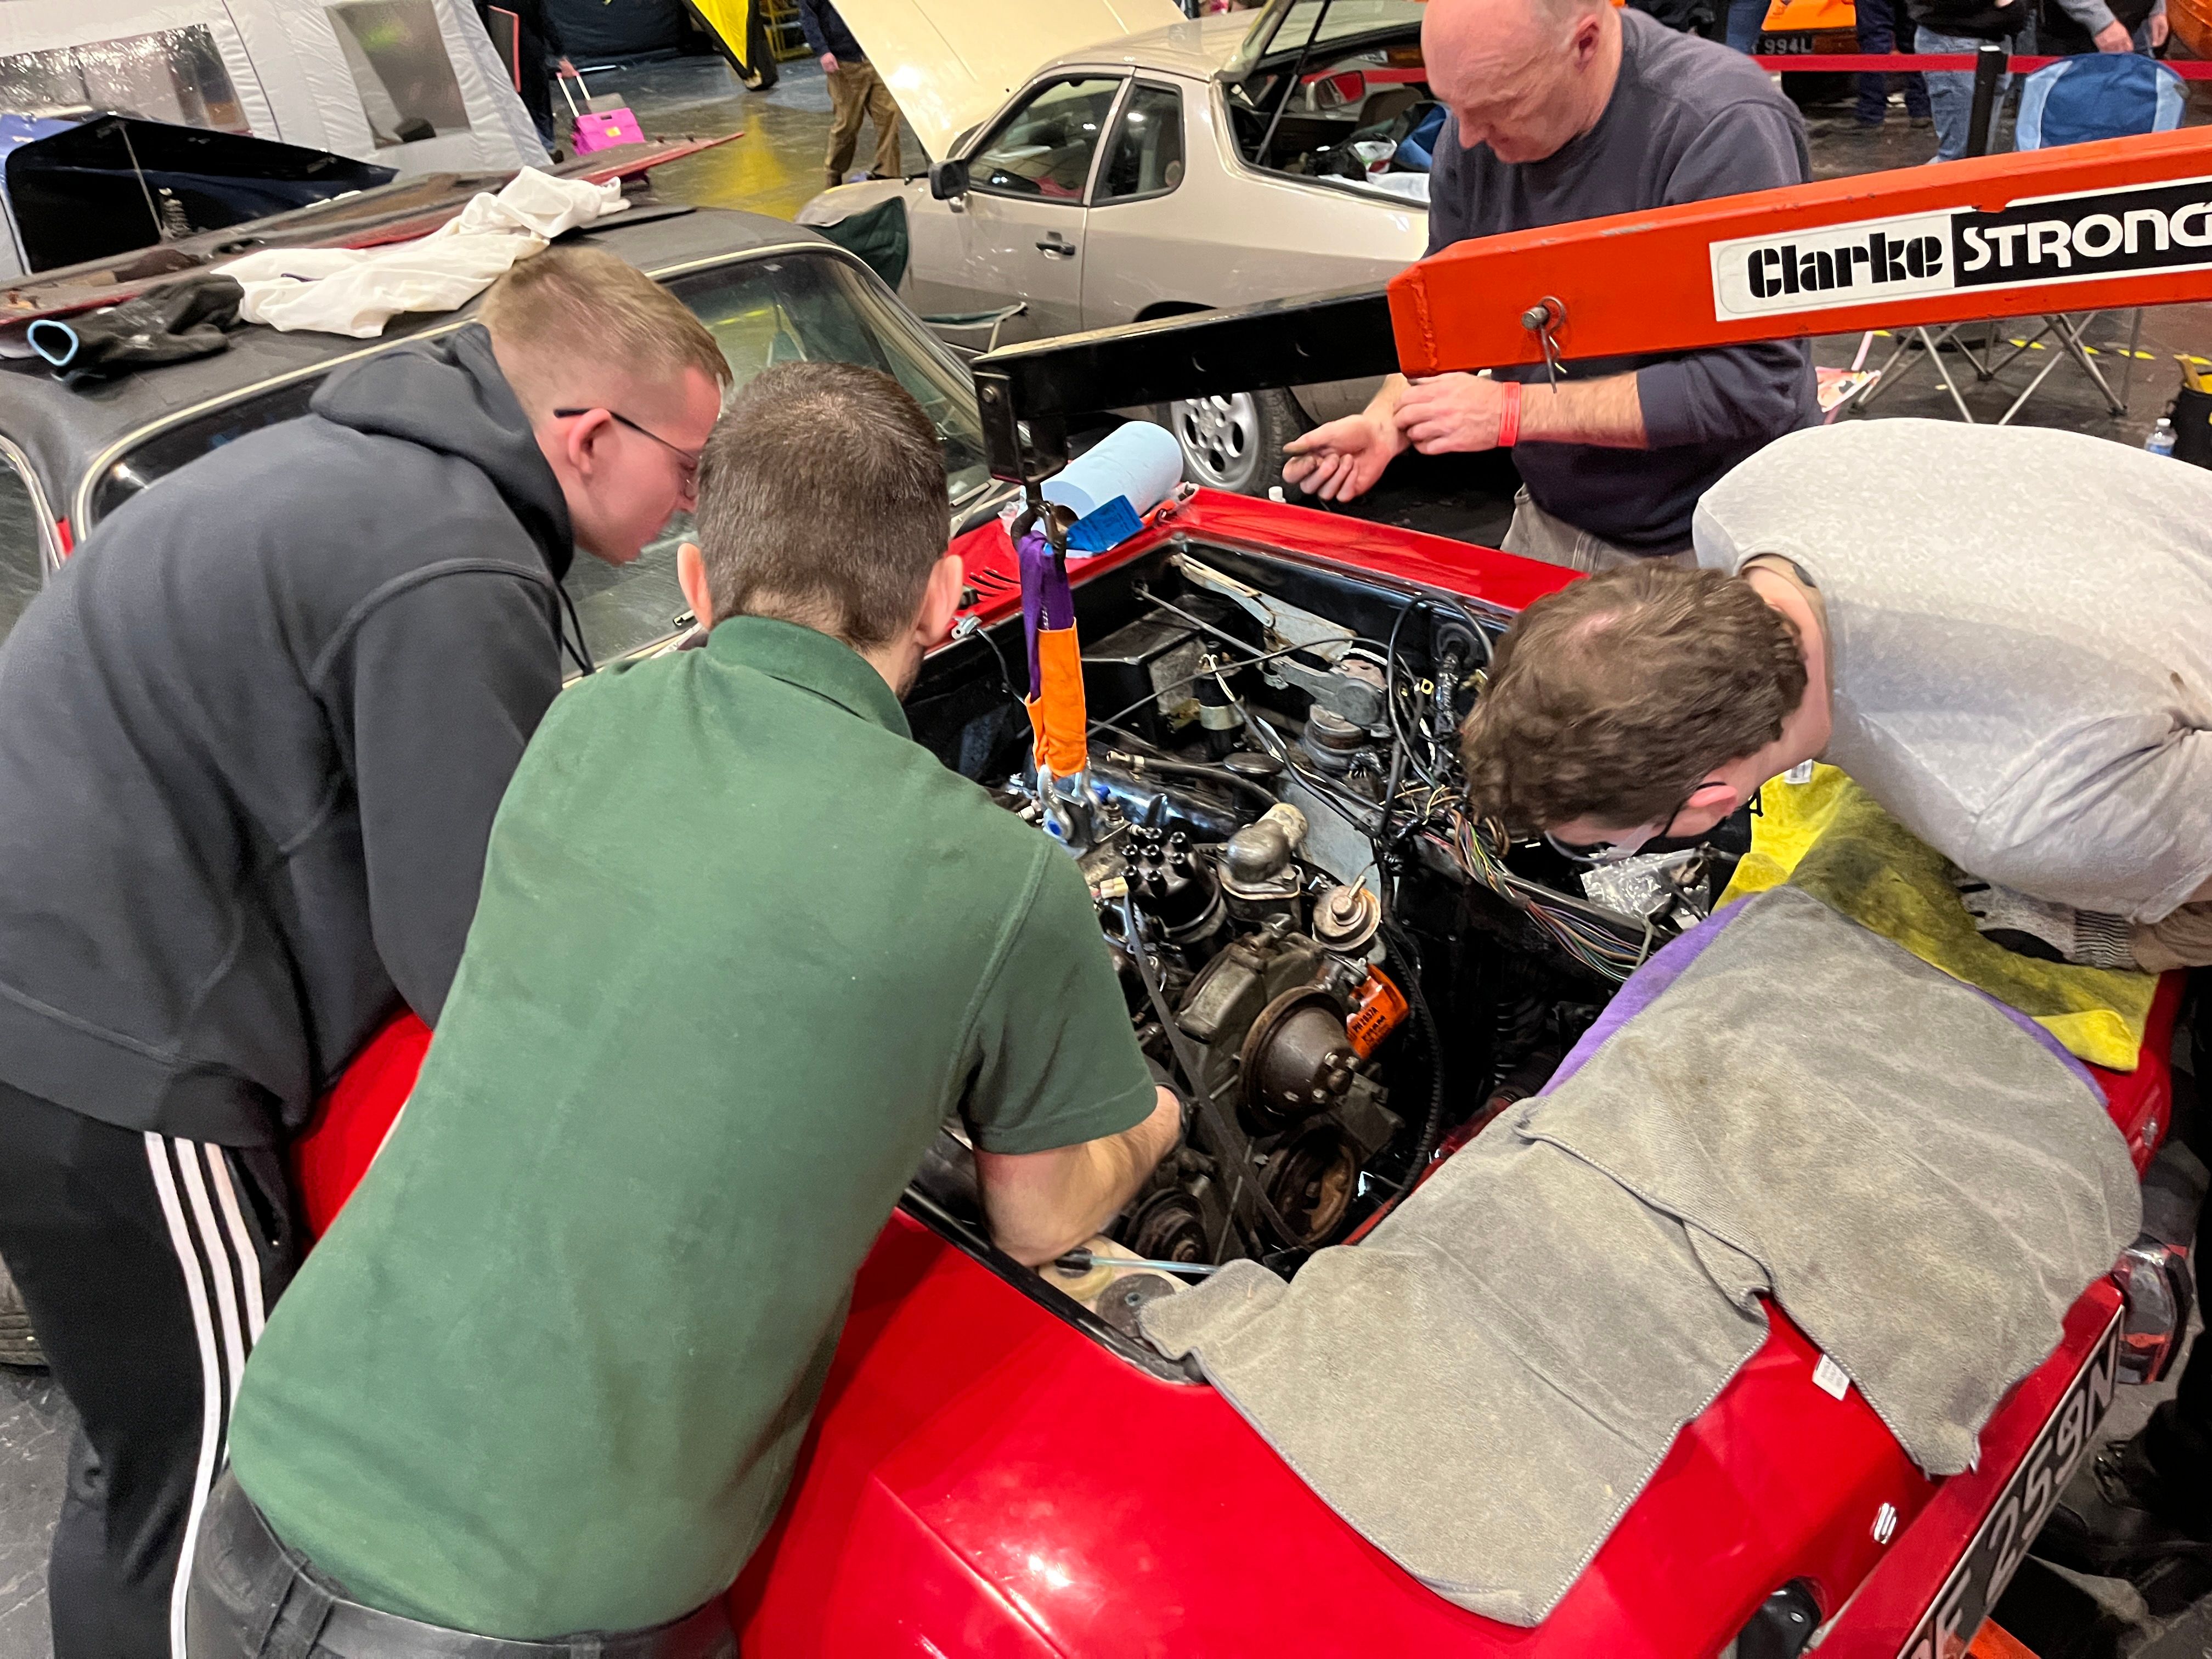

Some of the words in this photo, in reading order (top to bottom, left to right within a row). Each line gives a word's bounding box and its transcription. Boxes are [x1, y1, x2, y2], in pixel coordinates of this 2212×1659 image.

[1764, 37, 1812, 54] 994L
[1748, 232, 1943, 298] Clarke
[1910, 1566, 1971, 1659] F
[1985, 1331, 2117, 1606] 259N
